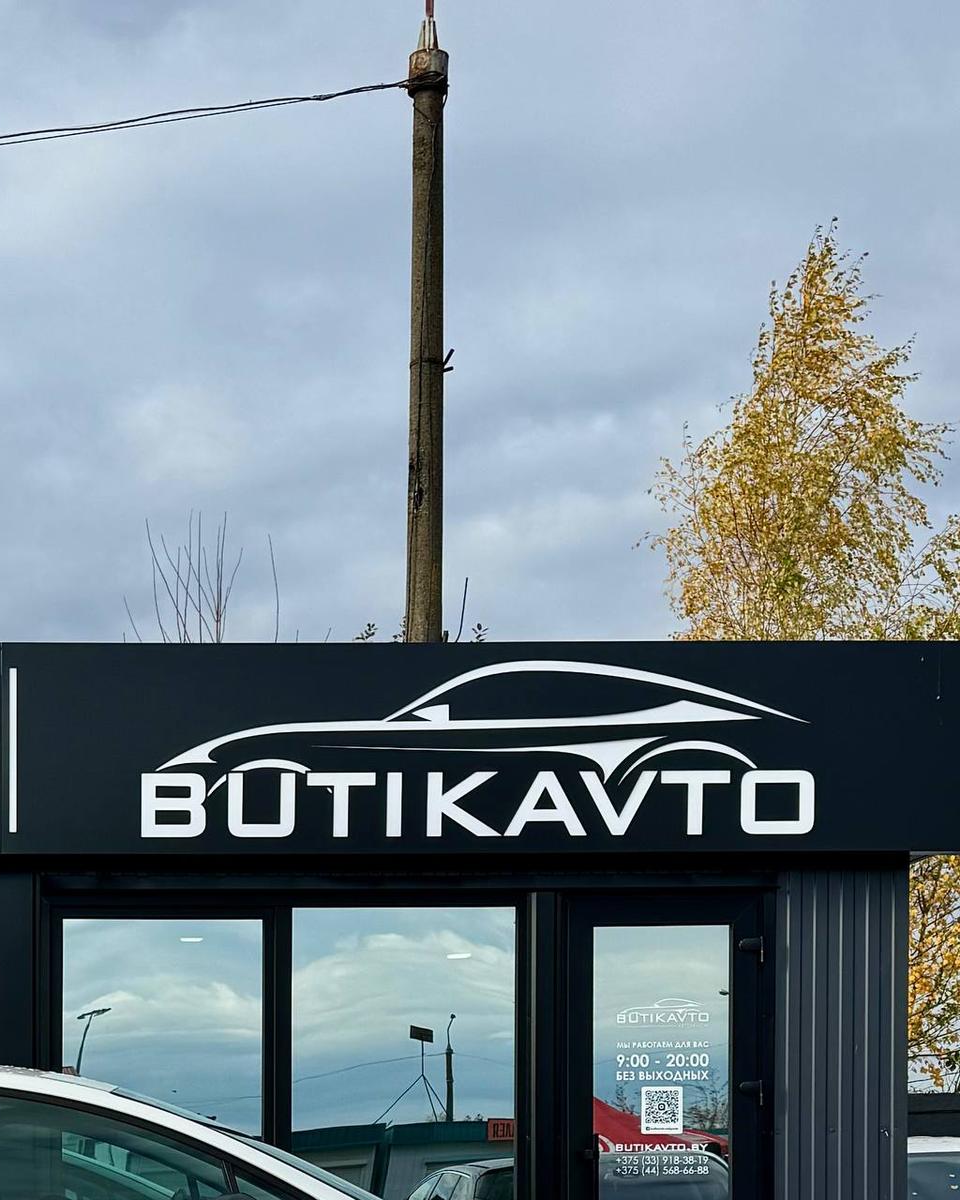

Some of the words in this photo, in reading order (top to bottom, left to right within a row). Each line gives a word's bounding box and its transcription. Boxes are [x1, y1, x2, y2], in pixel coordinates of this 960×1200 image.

[141, 769, 815, 838] BUTIKAVTO
[616, 1012, 709, 1023] BUTIKAVTO
[617, 1041, 630, 1049] МЫ
[632, 1041, 673, 1049] РАБОТАЕМ
[675, 1041, 691, 1049] ДЛЯ
[693, 1041, 709, 1049] ВАС
[616, 1054, 649, 1068] 9:00
[666, 1053, 709, 1067] 20:00
[616, 1070, 635, 1081] БЕЗ
[639, 1070, 709, 1081] ВЫХОДНЫХ
[615, 1143, 708, 1152] BUTIKAVTO.BY
[616, 1156, 639, 1165] +375
[641, 1155, 659, 1166] (33)
[662, 1156, 709, 1165] 918-38-19
[616, 1166, 639, 1175] +375
[641, 1166, 659, 1176] (44)
[662, 1166, 709, 1175] 568-66-88
